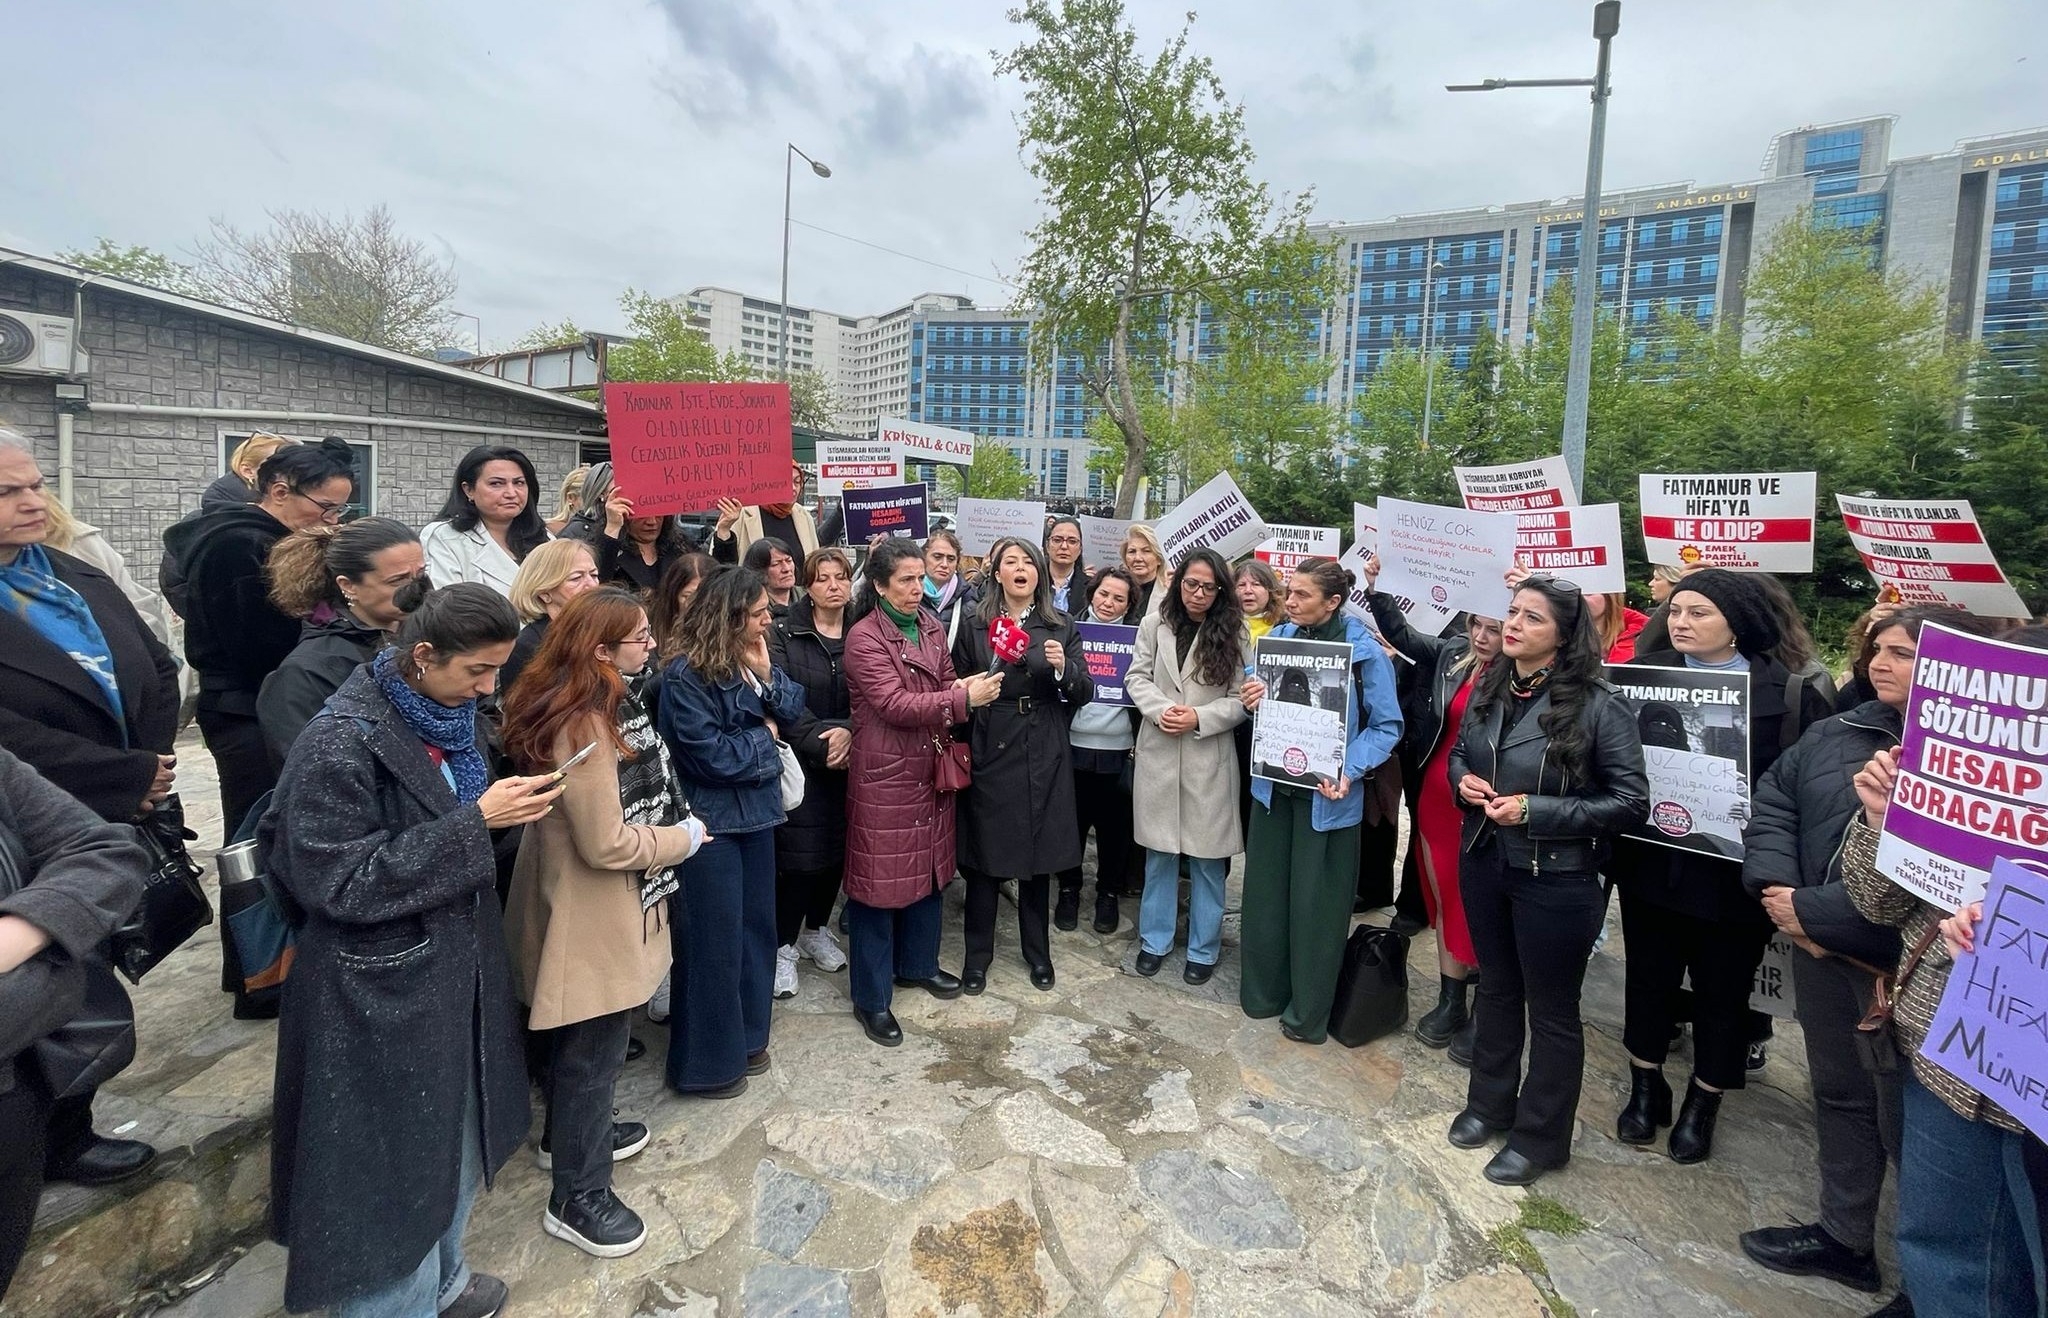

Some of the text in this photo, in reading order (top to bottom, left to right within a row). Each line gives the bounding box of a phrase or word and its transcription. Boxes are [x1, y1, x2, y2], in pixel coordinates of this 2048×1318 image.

[1655, 190, 1749, 210] ANADOLU
[934, 439, 943, 451] &
[945, 440, 972, 455] CAFE
[876, 466, 892, 475] VAR!
[1508, 468, 1544, 480] KORUYAN
[1499, 483, 1524, 494] DÜZENE
[1525, 479, 1548, 490] KARŞI
[1663, 478, 1780, 496] FATMANUR VE
[849, 500, 886, 511] FATMANUR
[886, 500, 895, 508] VE
[1528, 493, 1554, 507] VAR!
[1686, 496, 1750, 516] HİFA'YA
[1163, 490, 1239, 554] ÇOCUKLARIN KATİLİ
[1397, 512, 1437, 532] HENÜZ
[1914, 507, 1961, 520] OLANLAR
[1208, 506, 1252, 543] DÜZENİ
[1674, 520, 1765, 541] NE OLDU?
[1313, 530, 1324, 541] VE
[1277, 538, 1309, 553] HİFA'YA
[1871, 541, 1932, 560] SORUMLULAR
[1269, 553, 1281, 567] NE
[1537, 550, 1596, 567] YARGILA!
[1705, 552, 1746, 561] PARTİLİ
[1900, 563, 1953, 581] VERSİN!
[1900, 582, 1932, 592] EMEK
[1092, 641, 1104, 652] VE
[1260, 653, 1347, 672] FATMANUR ÇELİK
[1916, 656, 2048, 711] FATMANU
[1691, 685, 1741, 708] ÇELİK
[1927, 743, 2043, 798] HESAP
[1903, 857, 1964, 894] SOSYALİST
[1894, 865, 1963, 908] FEMİNİSTLER
